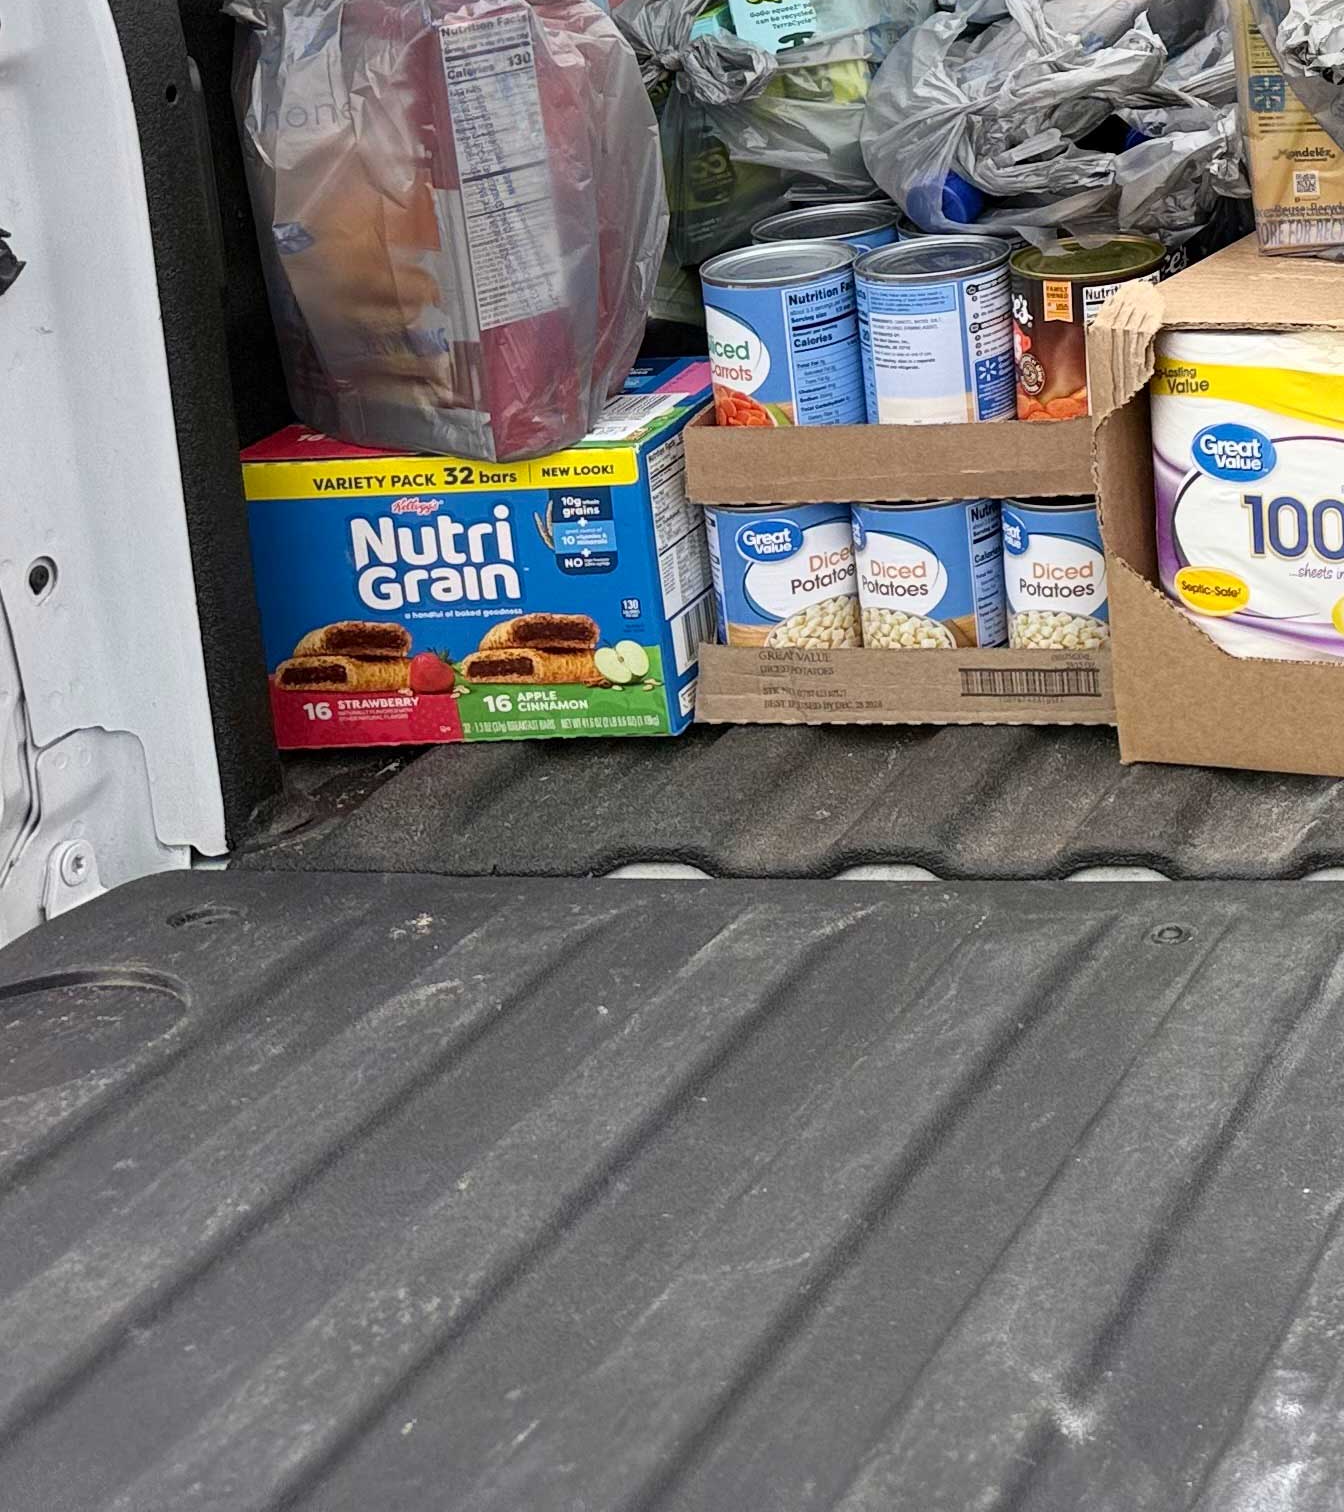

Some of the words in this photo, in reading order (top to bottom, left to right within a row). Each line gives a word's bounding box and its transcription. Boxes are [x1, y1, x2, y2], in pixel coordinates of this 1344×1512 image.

[441, 21, 494, 37] Nutrition
[447, 64, 495, 80] Calories
[507, 52, 531, 67] 130
[789, 288, 839, 306] Nutrition
[794, 333, 833, 348] Calories
[1168, 378, 1209, 394] Value
[1199, 435, 1262, 460] Great
[541, 466, 569, 478] NEW
[572, 463, 615, 477] LOOK!
[1214, 453, 1262, 471] Value
[313, 474, 388, 491] VARIETY
[391, 473, 436, 488] PACK
[443, 466, 475, 485] 32
[479, 469, 517, 485] bars
[391, 498, 439, 516] Kellogg's
[561, 496, 582, 506] 10g
[562, 506, 600, 518] grains
[350, 504, 516, 571] Nutri
[561, 536, 575, 545] 10
[742, 526, 792, 546] Great
[755, 539, 793, 555] Value
[564, 558, 583, 568] NO
[870, 559, 927, 578] Diced
[1032, 561, 1094, 579] Diced
[357, 561, 522, 611] Grain
[790, 565, 856, 595] Potatoe
[862, 576, 929, 597] Potatoes
[1019, 577, 1095, 598] Potatoes
[411, 609, 443, 620] handful
[454, 608, 481, 618] baked
[482, 607, 523, 619] goodness
[623, 600, 638, 610] 130
[759, 650, 796, 662] GREAT
[799, 651, 833, 663] VALUE
[303, 701, 332, 721] 16
[338, 696, 419, 710] STRAWBERRY
[483, 695, 513, 713] 16
[517, 690, 557, 701] APPLE
[518, 698, 588, 713] CINNAMON
